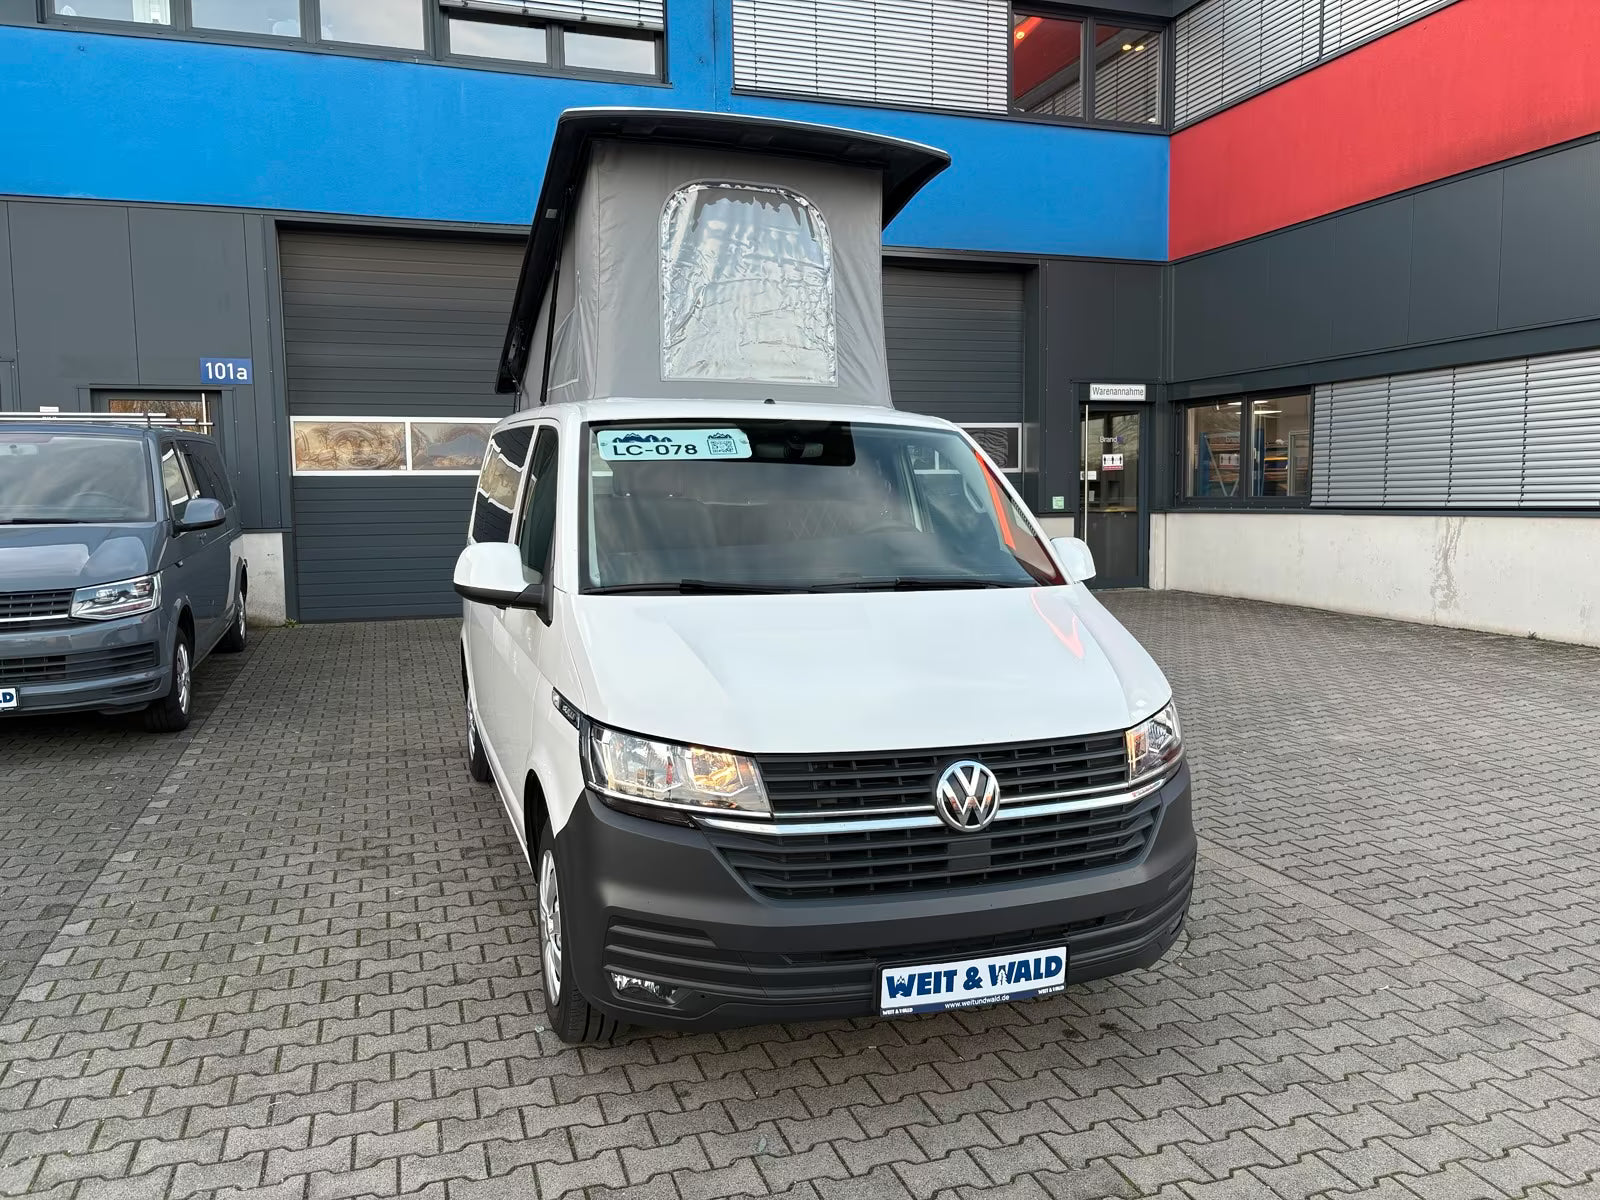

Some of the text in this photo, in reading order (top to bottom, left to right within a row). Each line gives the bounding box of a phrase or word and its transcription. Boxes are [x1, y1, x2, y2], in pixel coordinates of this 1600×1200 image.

[205, 362, 248, 380] 101a
[1092, 386, 1144, 396] Warenannahme
[613, 444, 698, 456] LC-078
[885, 955, 1063, 999] WEIT & WALD
[944, 994, 1010, 1009] www.weitundwald.de
